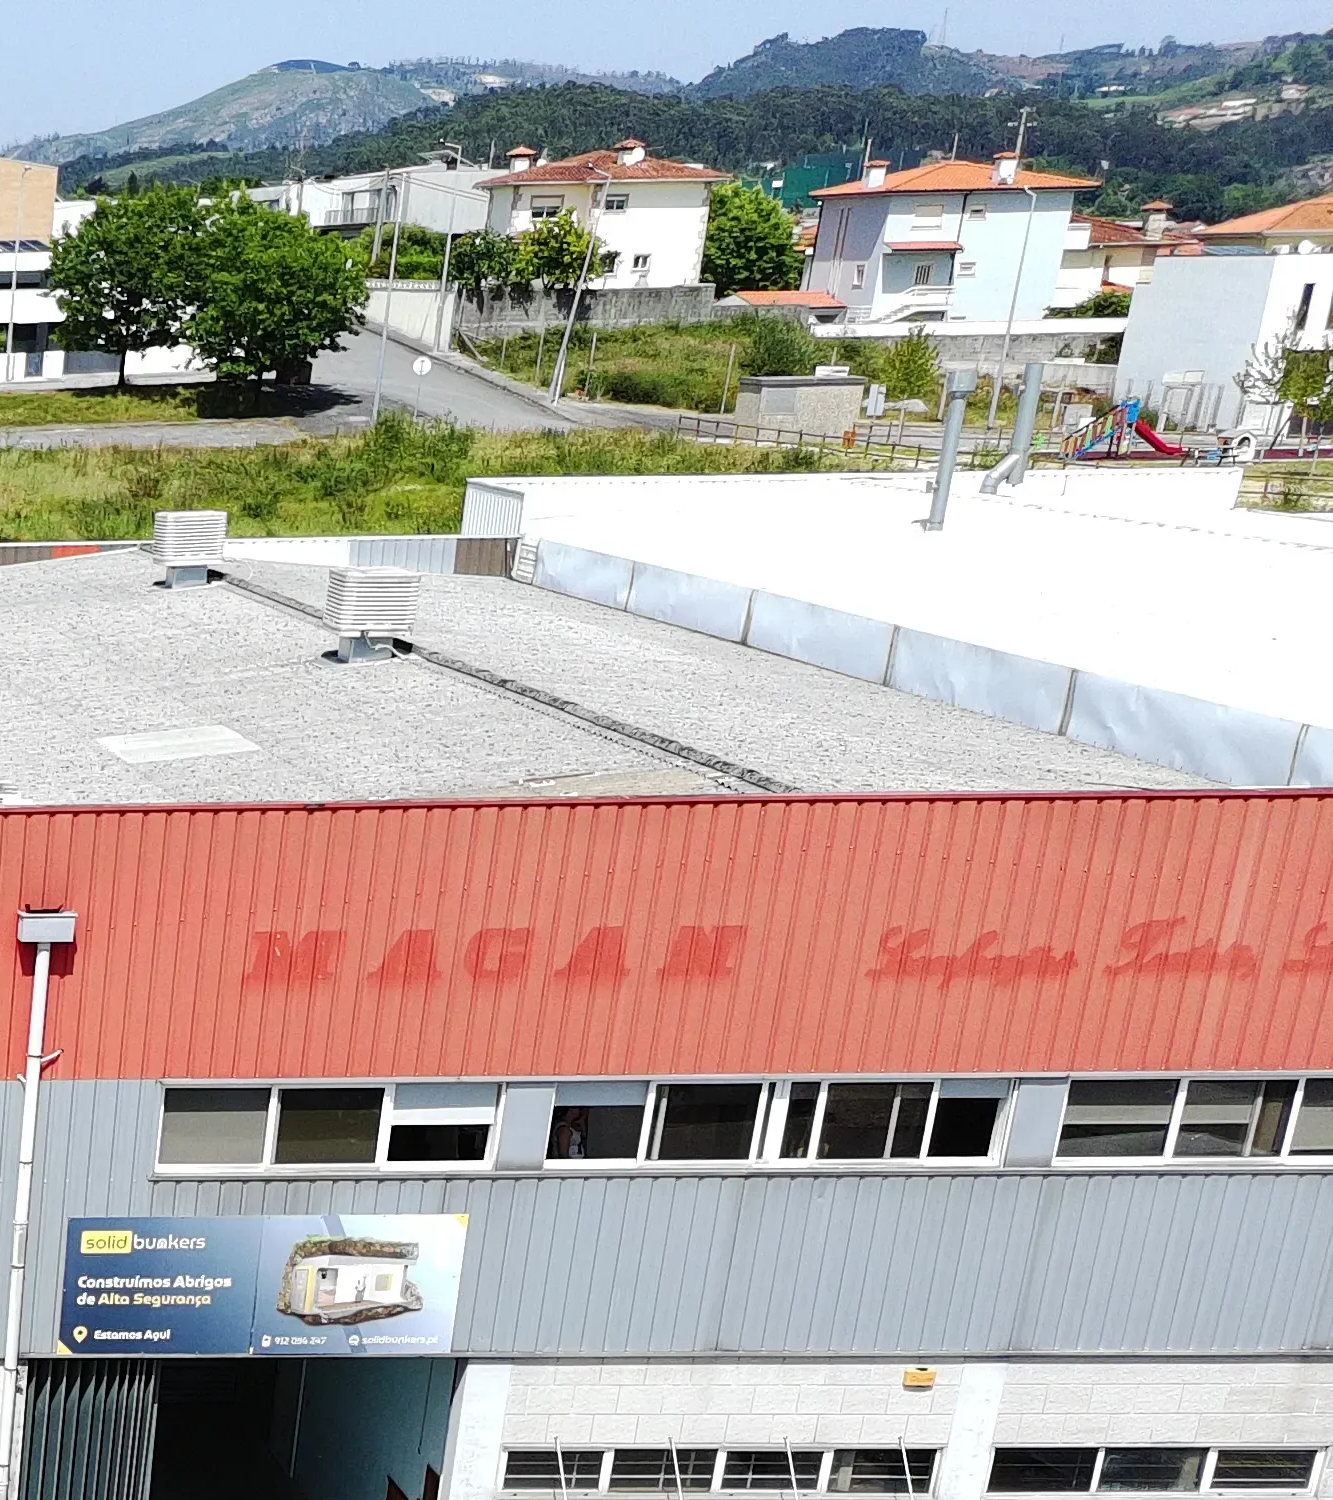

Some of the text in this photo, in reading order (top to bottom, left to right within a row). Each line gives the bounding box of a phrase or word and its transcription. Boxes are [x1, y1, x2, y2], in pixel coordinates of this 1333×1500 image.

[243, 925, 748, 979] MAGAN
[86, 1234, 206, 1250] solid bunkers
[173, 1275, 232, 1290] Abrigos
[77, 1292, 211, 1308] de Alta Segurança
[94, 1329, 142, 1340] Estamos
